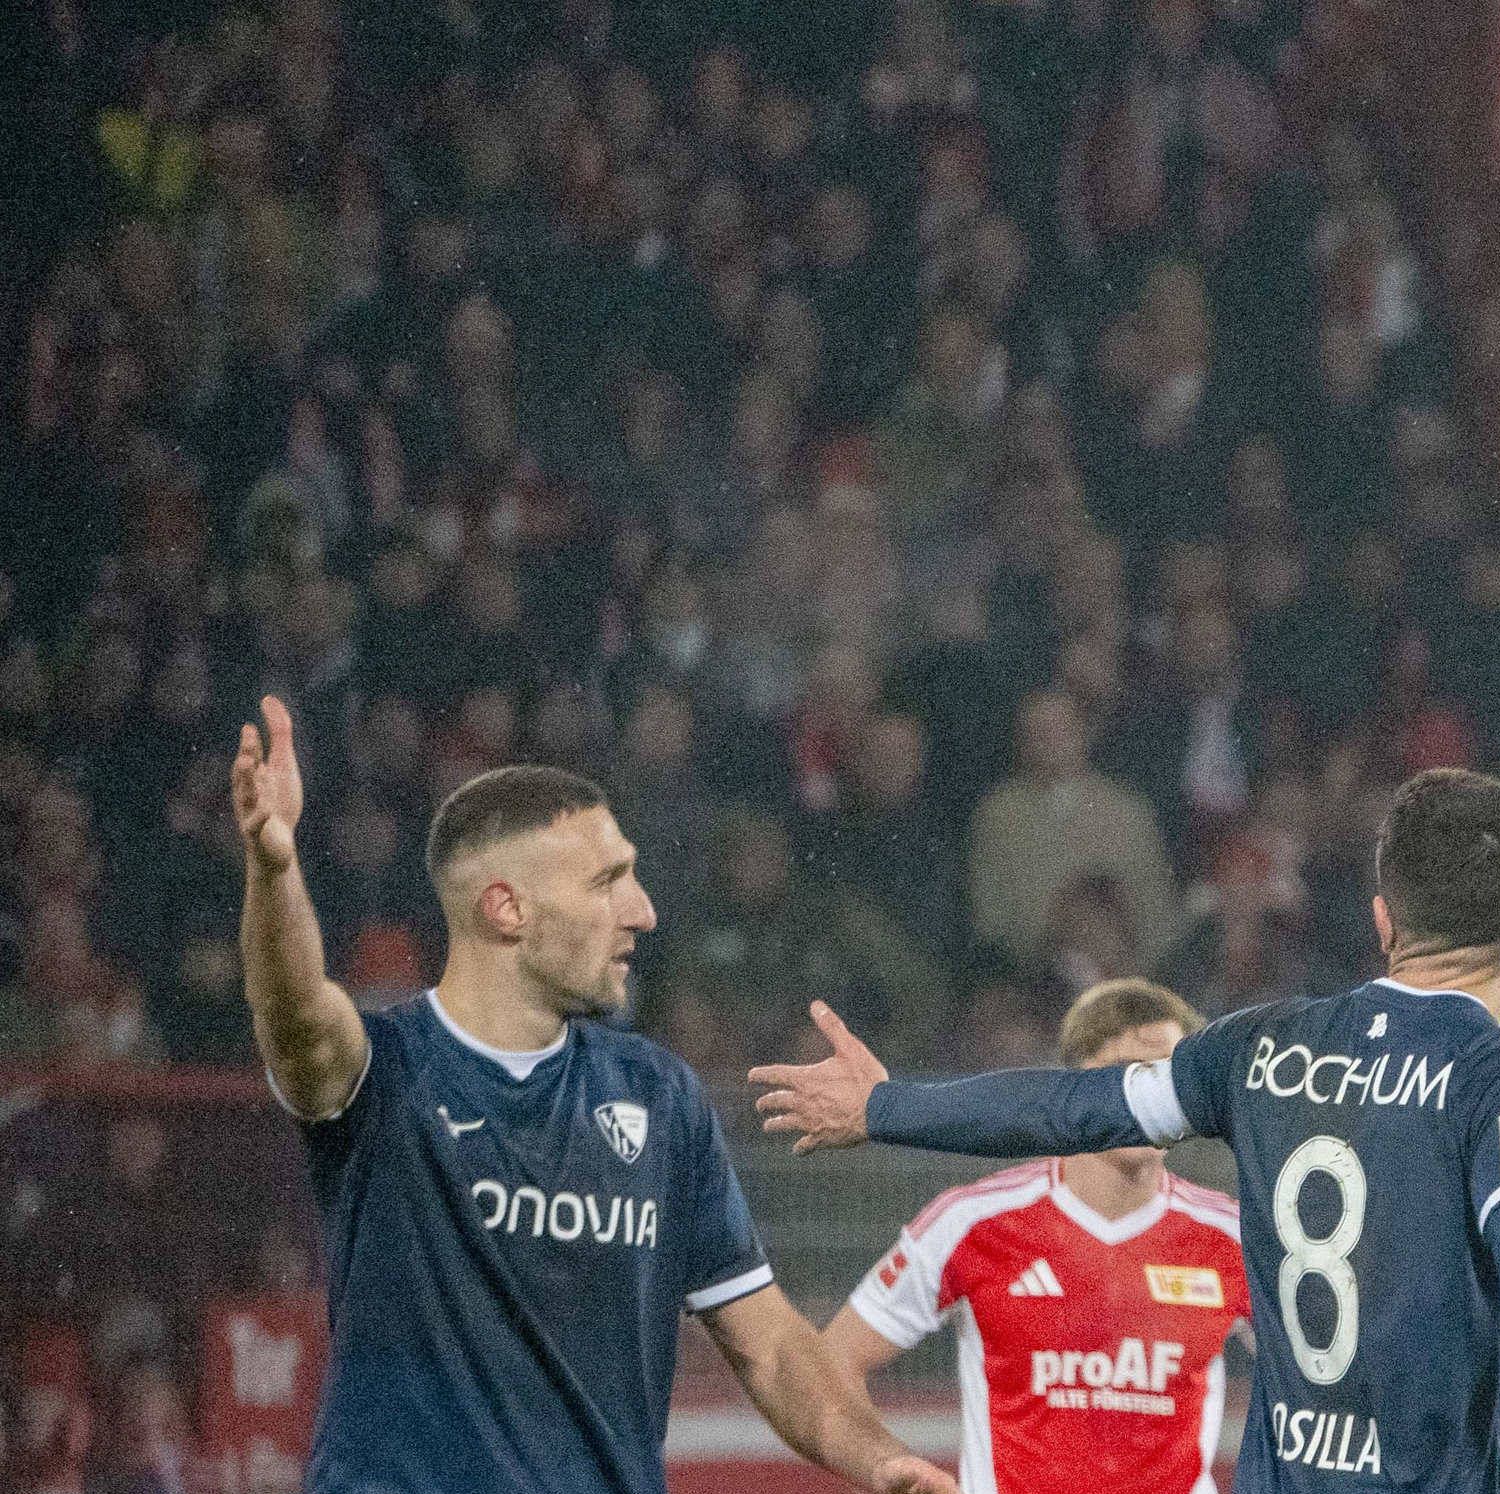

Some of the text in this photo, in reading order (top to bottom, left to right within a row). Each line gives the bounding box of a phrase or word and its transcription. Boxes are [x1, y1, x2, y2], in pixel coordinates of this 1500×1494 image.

[1246, 1036, 1455, 1110] BOCHUM
[1274, 1135, 1367, 1386] 8
[1031, 1337, 1186, 1396] proAF
